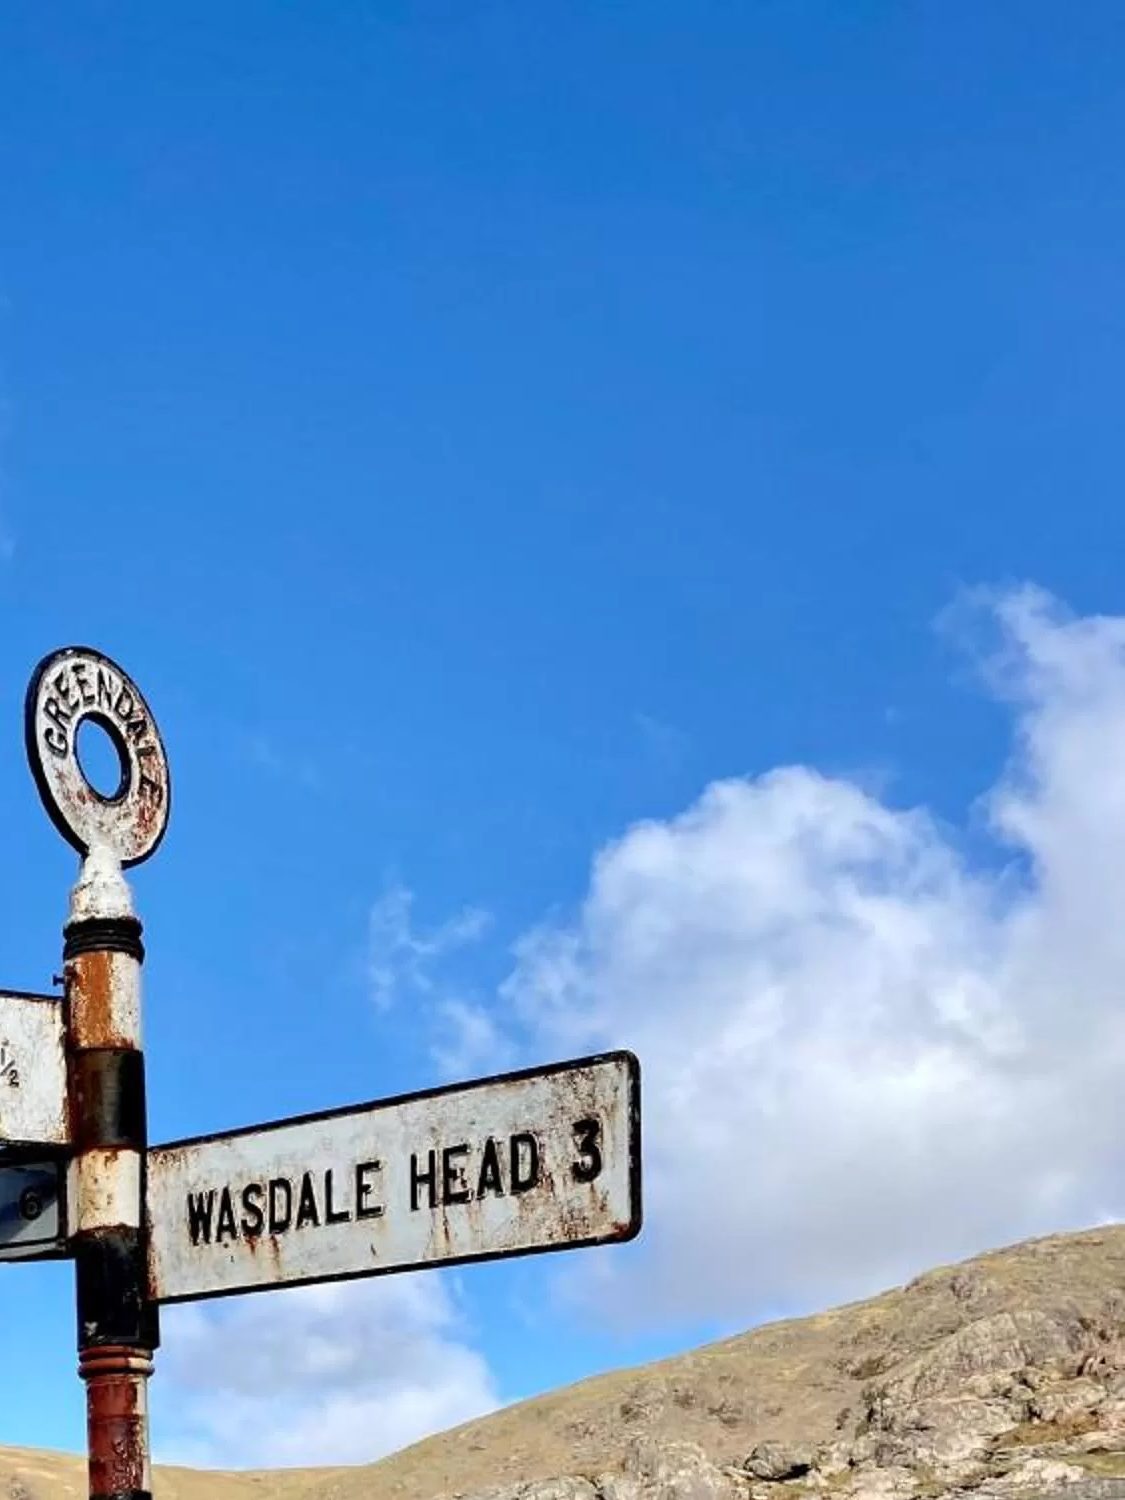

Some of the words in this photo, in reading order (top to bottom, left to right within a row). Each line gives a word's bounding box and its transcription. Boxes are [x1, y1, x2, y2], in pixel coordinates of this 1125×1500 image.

[19, 1187, 43, 1221] 6
[188, 1161, 383, 1246] WASDALE
[411, 1133, 540, 1211] HEAD
[572, 1119, 601, 1183] 3
